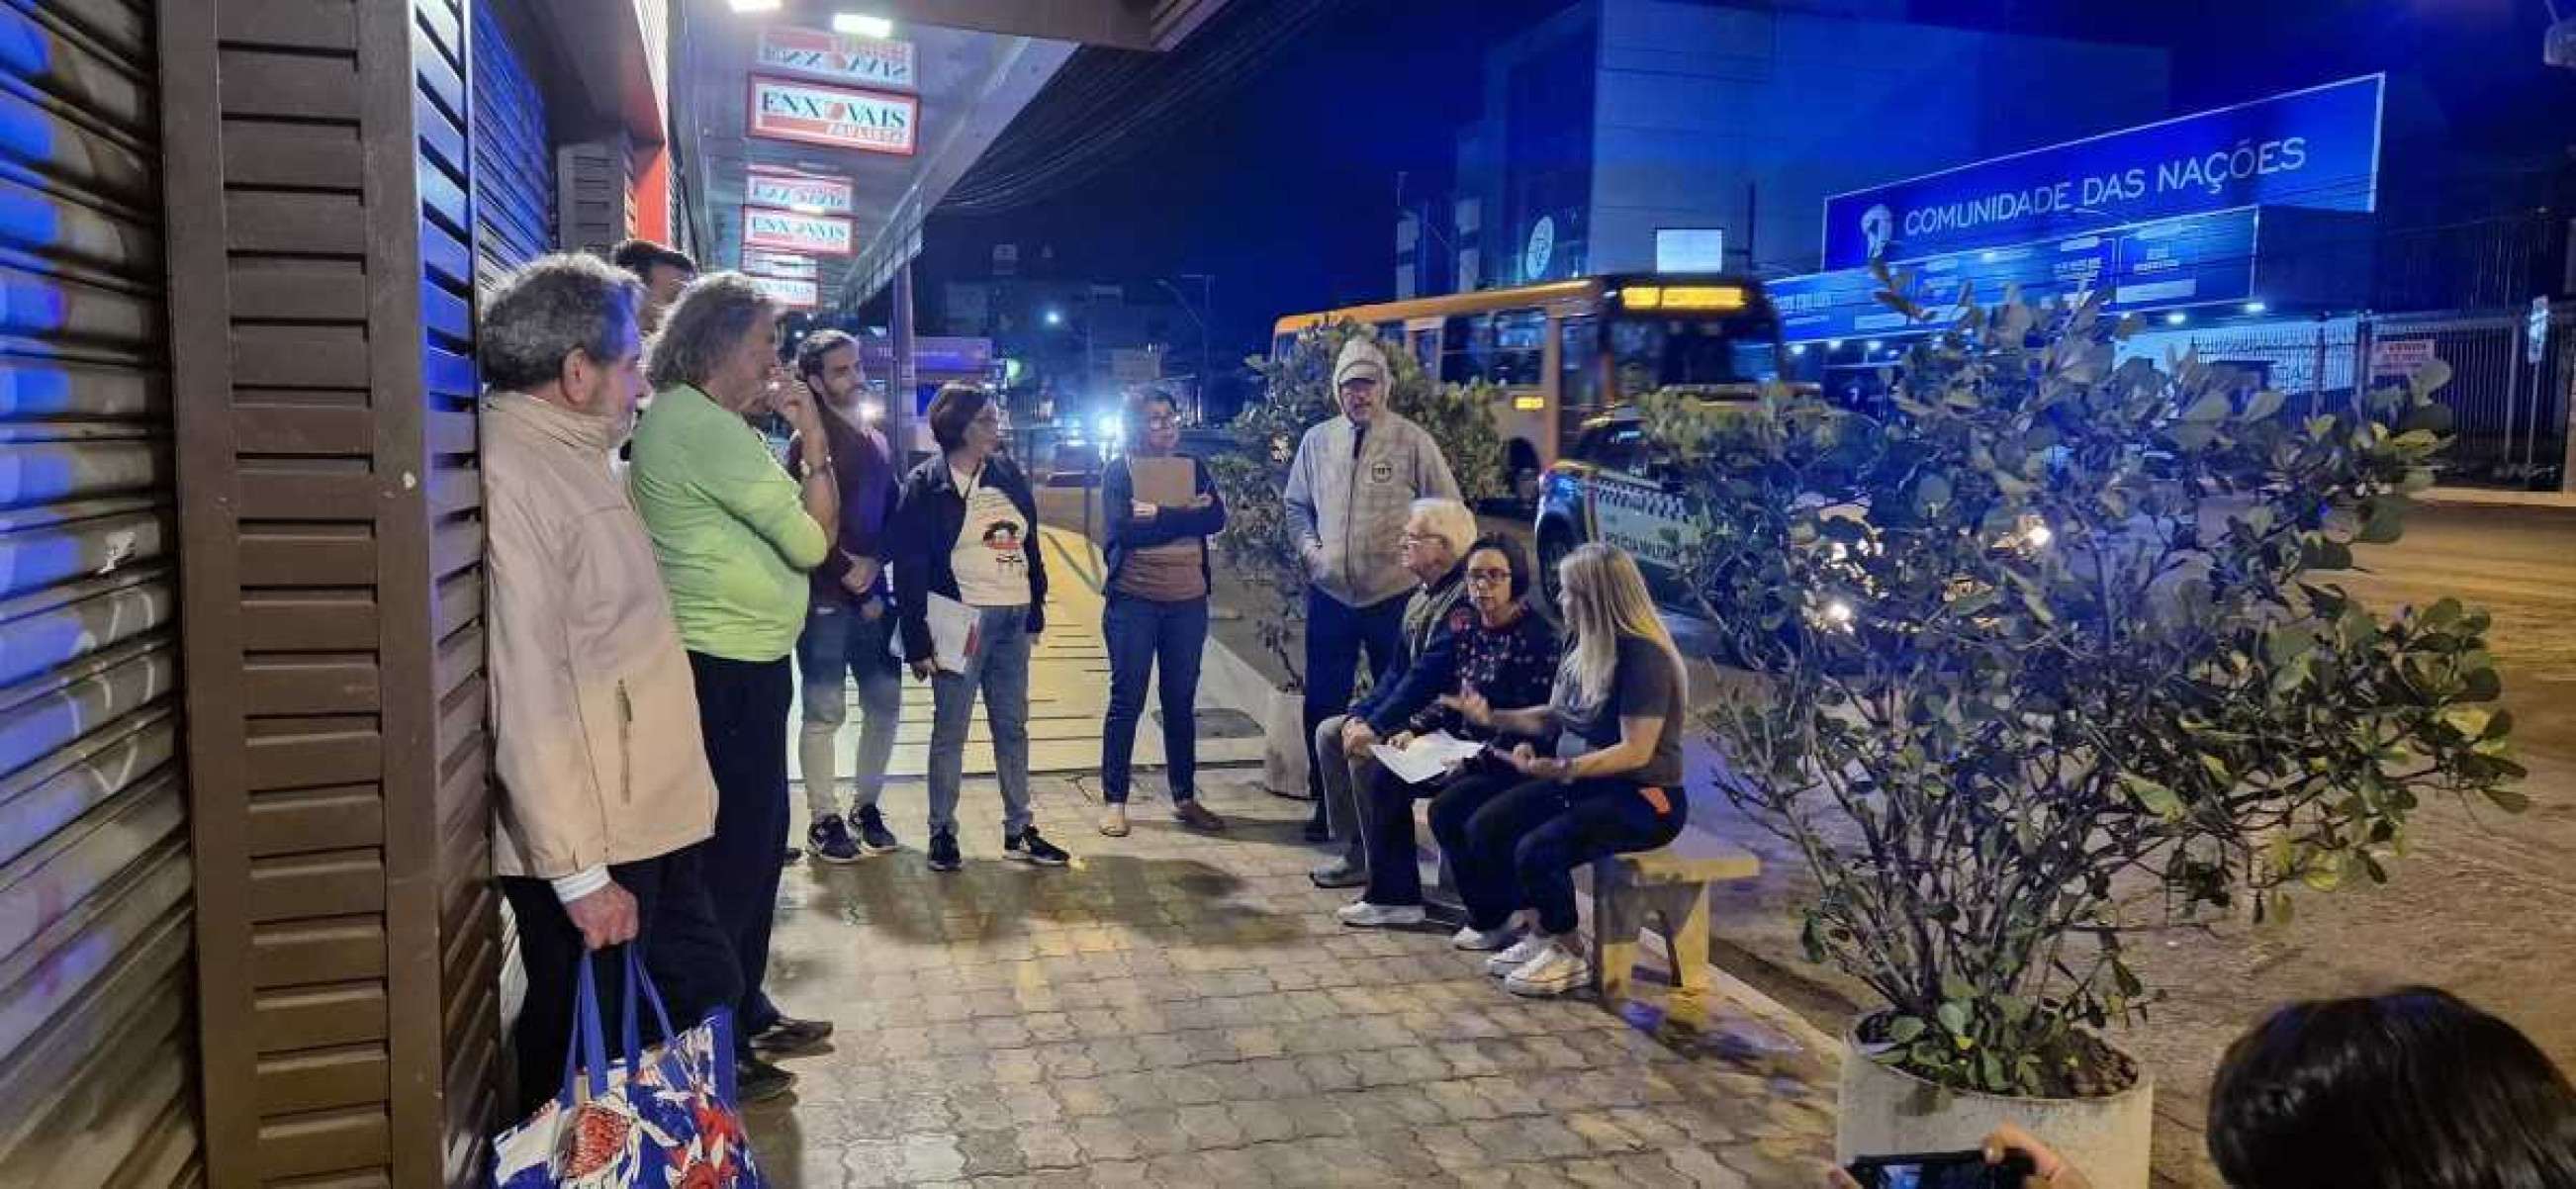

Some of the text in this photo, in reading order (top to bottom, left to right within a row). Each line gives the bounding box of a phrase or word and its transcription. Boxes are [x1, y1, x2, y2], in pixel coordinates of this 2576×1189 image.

[1905, 137, 2308, 236] COMUNIDADE DAS NAÇÕES
